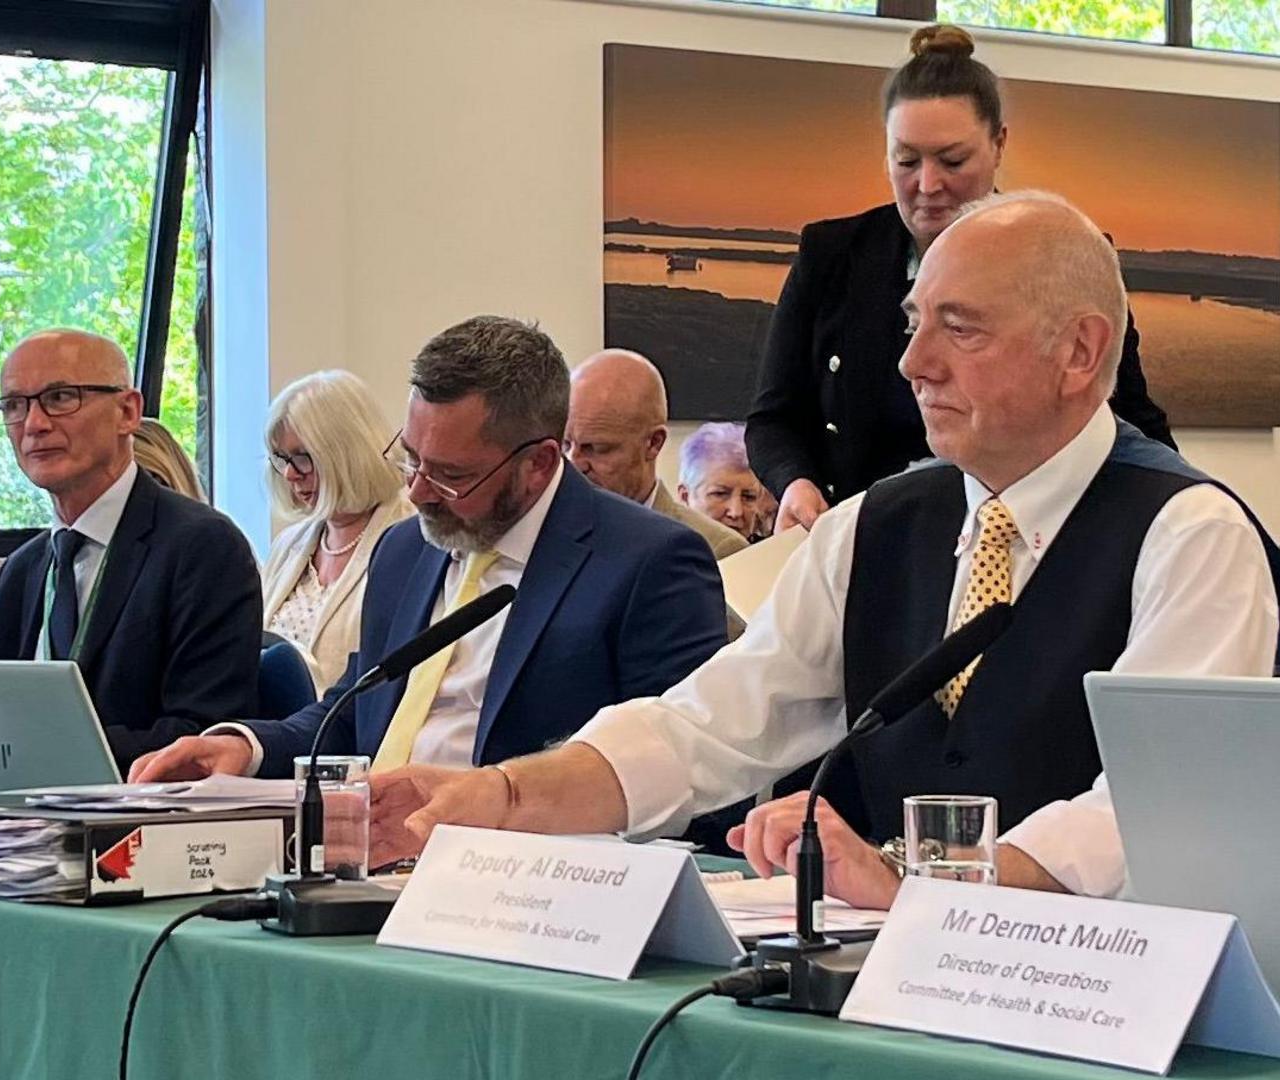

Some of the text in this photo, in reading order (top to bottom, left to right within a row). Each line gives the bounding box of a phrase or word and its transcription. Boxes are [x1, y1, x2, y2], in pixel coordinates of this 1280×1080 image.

[190, 868, 215, 879] 2024
[459, 848, 523, 880] Deputy
[551, 859, 629, 887] Brouard
[493, 890, 552, 911] President
[424, 910, 601, 944] Committee for Health & Social Care
[941, 908, 1149, 957] Mr Dermot Mullin
[937, 953, 1112, 994] Director of Operations
[898, 980, 1125, 1028] Committee for Health & Social Care
